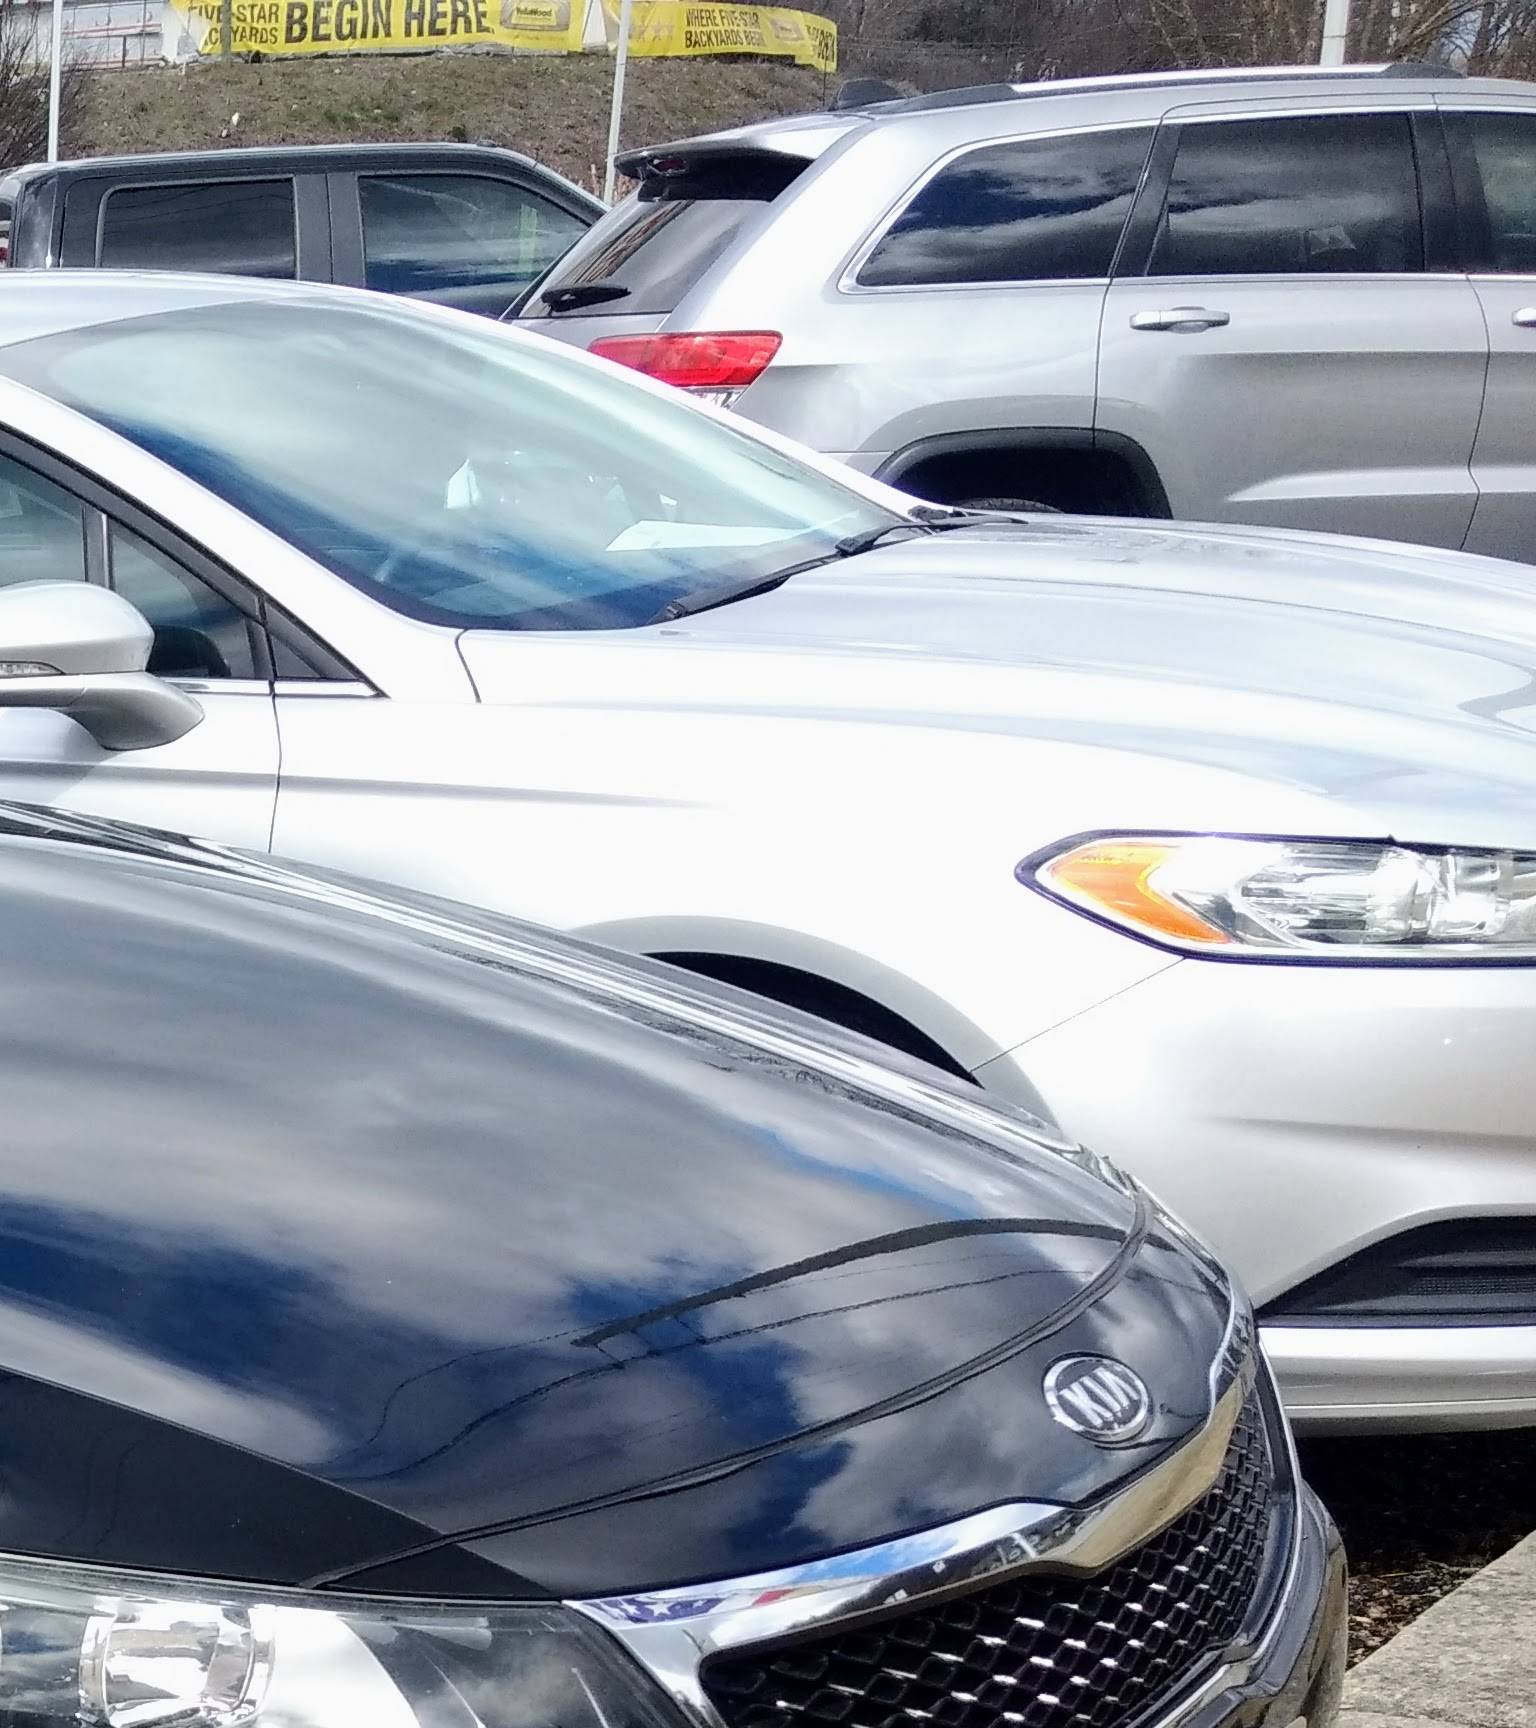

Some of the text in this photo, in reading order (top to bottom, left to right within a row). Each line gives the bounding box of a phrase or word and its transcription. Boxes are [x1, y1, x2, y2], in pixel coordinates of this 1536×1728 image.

[284, 0, 393, 44] BEGIN
[685, 30, 743, 48] BACKYARDS
[1059, 1366, 1141, 1429] KIA
